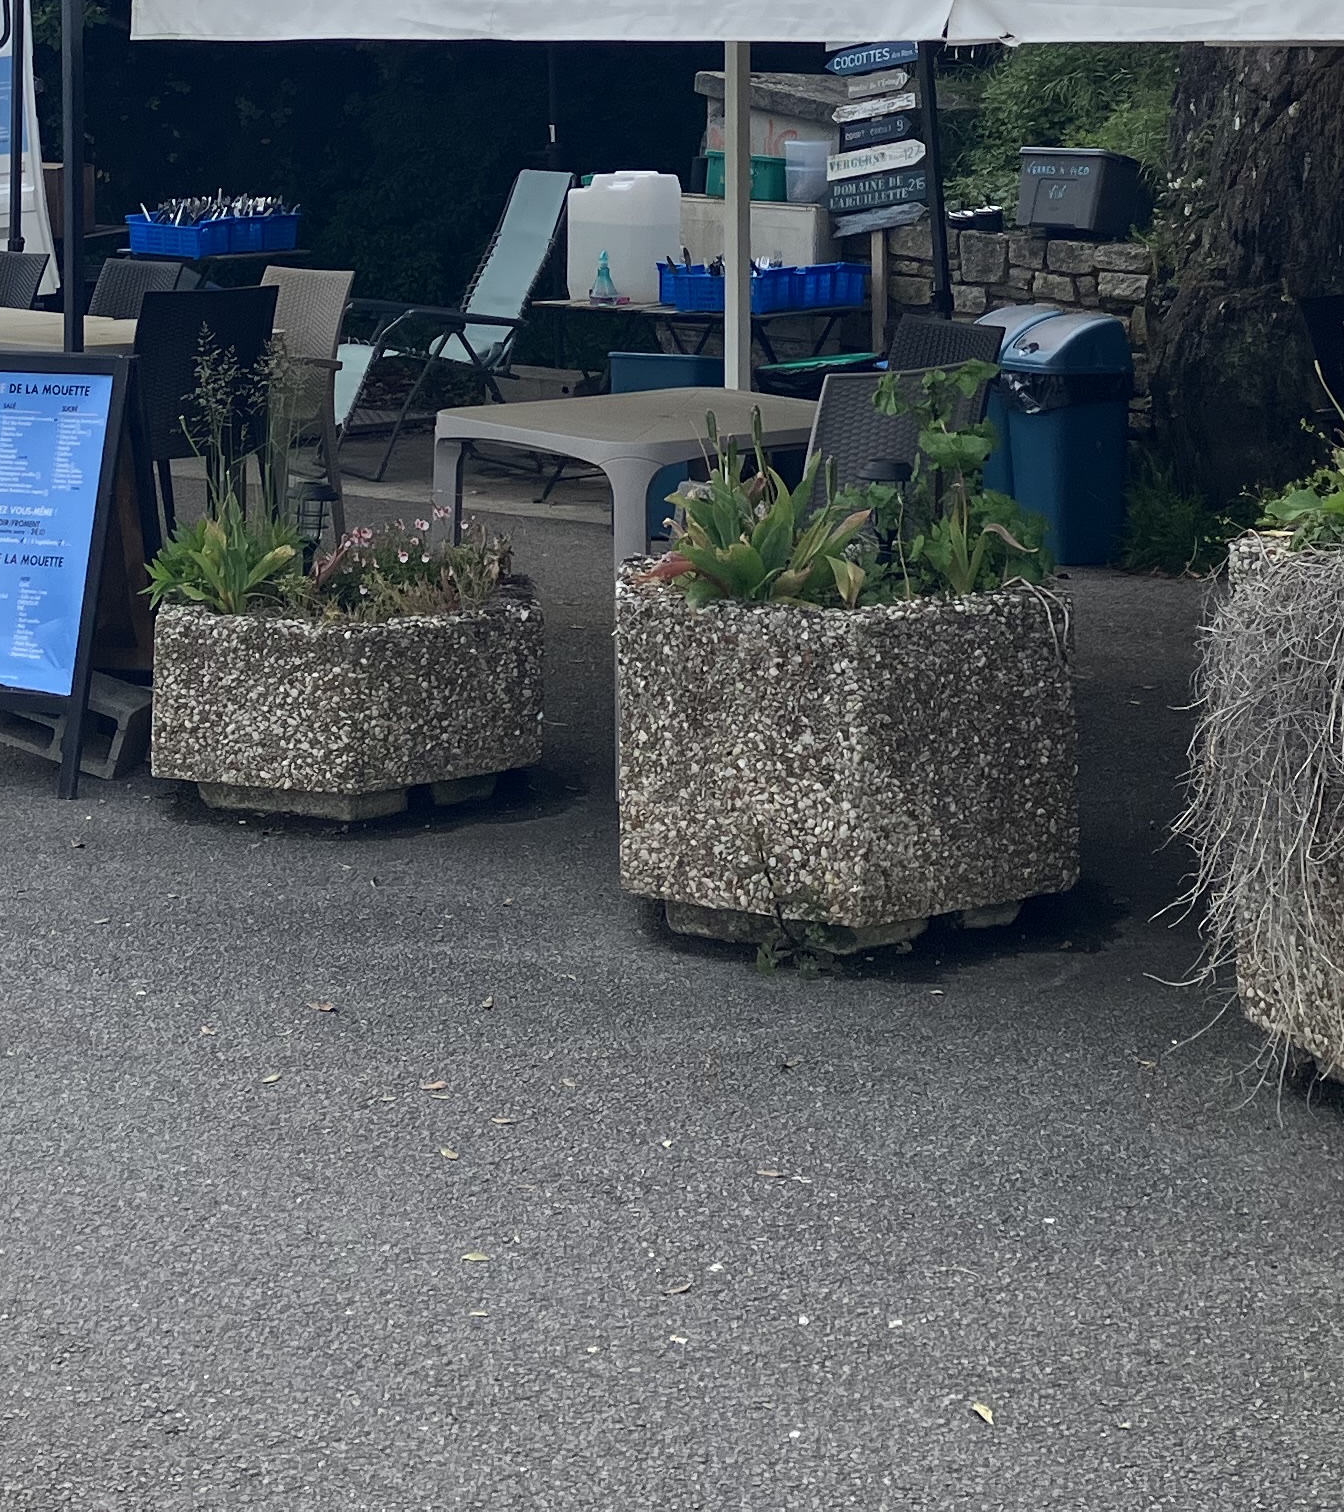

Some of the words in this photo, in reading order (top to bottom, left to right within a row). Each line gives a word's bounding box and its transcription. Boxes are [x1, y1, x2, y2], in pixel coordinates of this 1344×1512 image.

[833, 48, 890, 70] COCOTTES
[896, 119, 904, 131] 9
[834, 178, 885, 197] DOMAINE
[888, 175, 904, 188] DE
[830, 188, 909, 209] L'AIGUILLETTE
[8, 382, 23, 394] DE
[24, 383, 39, 394] LA
[41, 383, 91, 397] MOUETTE
[3, 553, 17, 564] LA
[20, 554, 64, 568] MOUETTE
